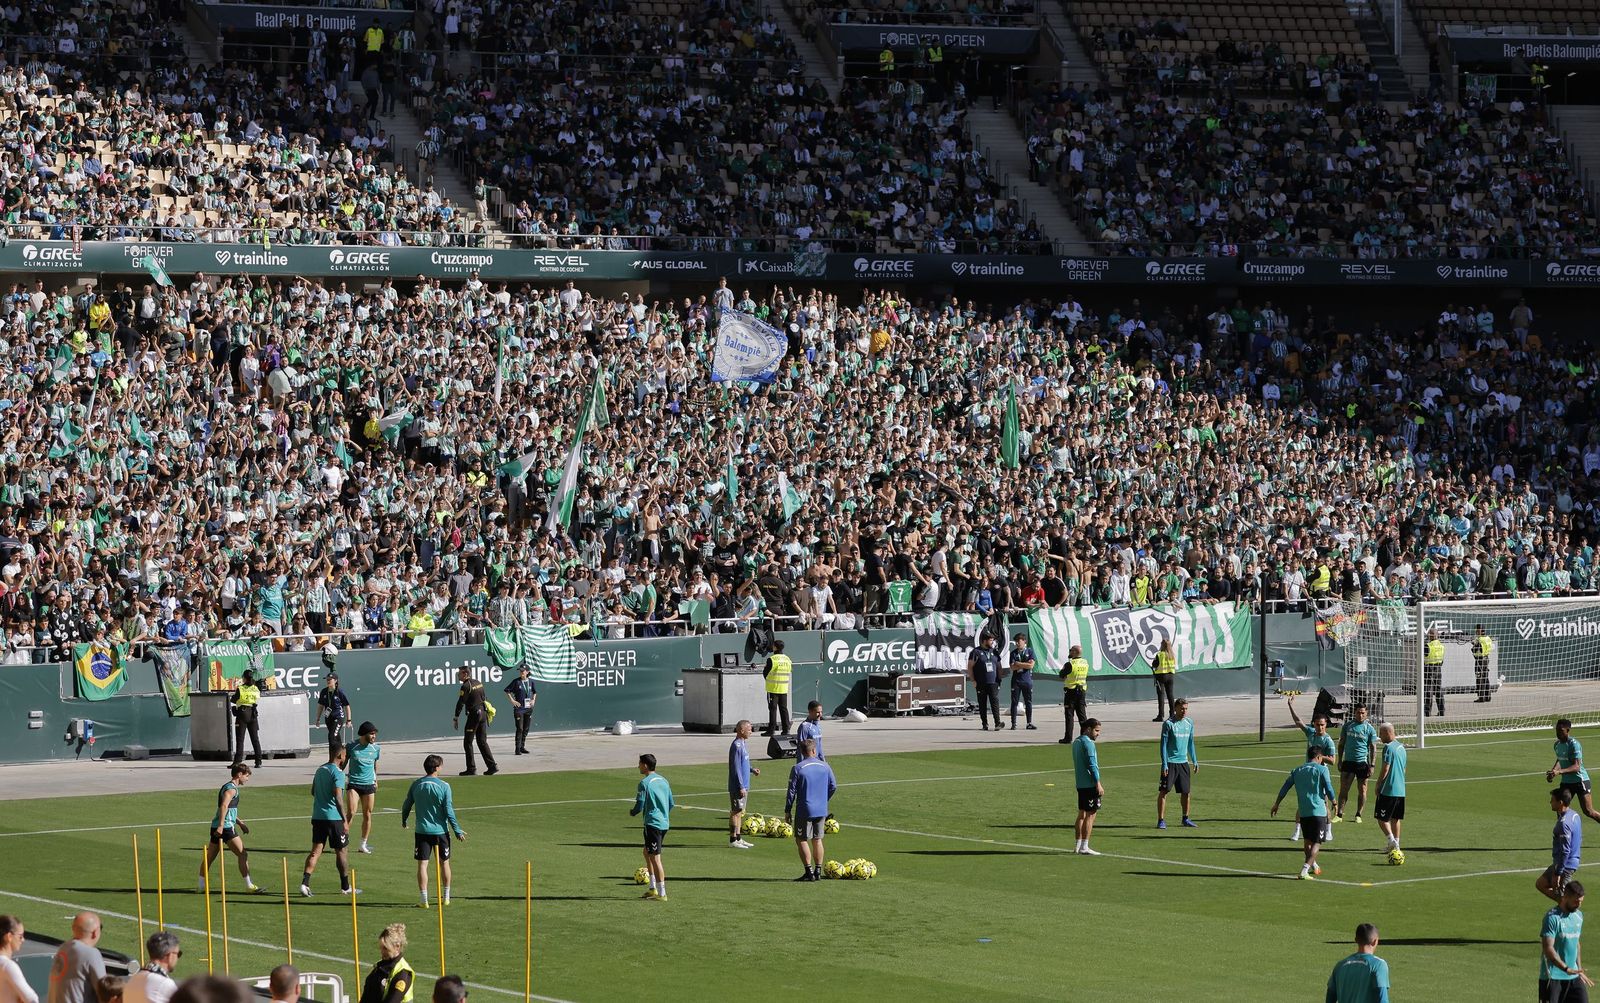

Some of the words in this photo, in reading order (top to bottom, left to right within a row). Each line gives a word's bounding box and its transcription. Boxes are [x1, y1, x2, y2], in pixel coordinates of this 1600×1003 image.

[306, 14, 356, 32] Blompié
[40, 247, 83, 260] GREE
[124, 245, 174, 257] FOREVER
[233, 251, 288, 266] trainline
[346, 252, 390, 265] GREE
[431, 251, 493, 267] Cruzcampo
[534, 255, 590, 266] REVEL
[641, 260, 663, 270] AUS
[665, 260, 707, 270] GLOBAL
[1061, 259, 1109, 271] FOREVER
[330, 264, 390, 272] CLIMATIZACIÓN
[760, 260, 795, 273] CaixaB
[871, 260, 914, 272] GREE
[970, 262, 1024, 276] trainline
[1163, 264, 1206, 275] GREE
[1243, 262, 1305, 276] Cruzcampo
[1340, 264, 1396, 274] REVEL
[1454, 266, 1508, 278] trainline
[1069, 270, 1101, 281] GREEN
[724, 335, 761, 358] Balompié
[274, 666, 321, 689] REE
[577, 669, 625, 688] GREEN
